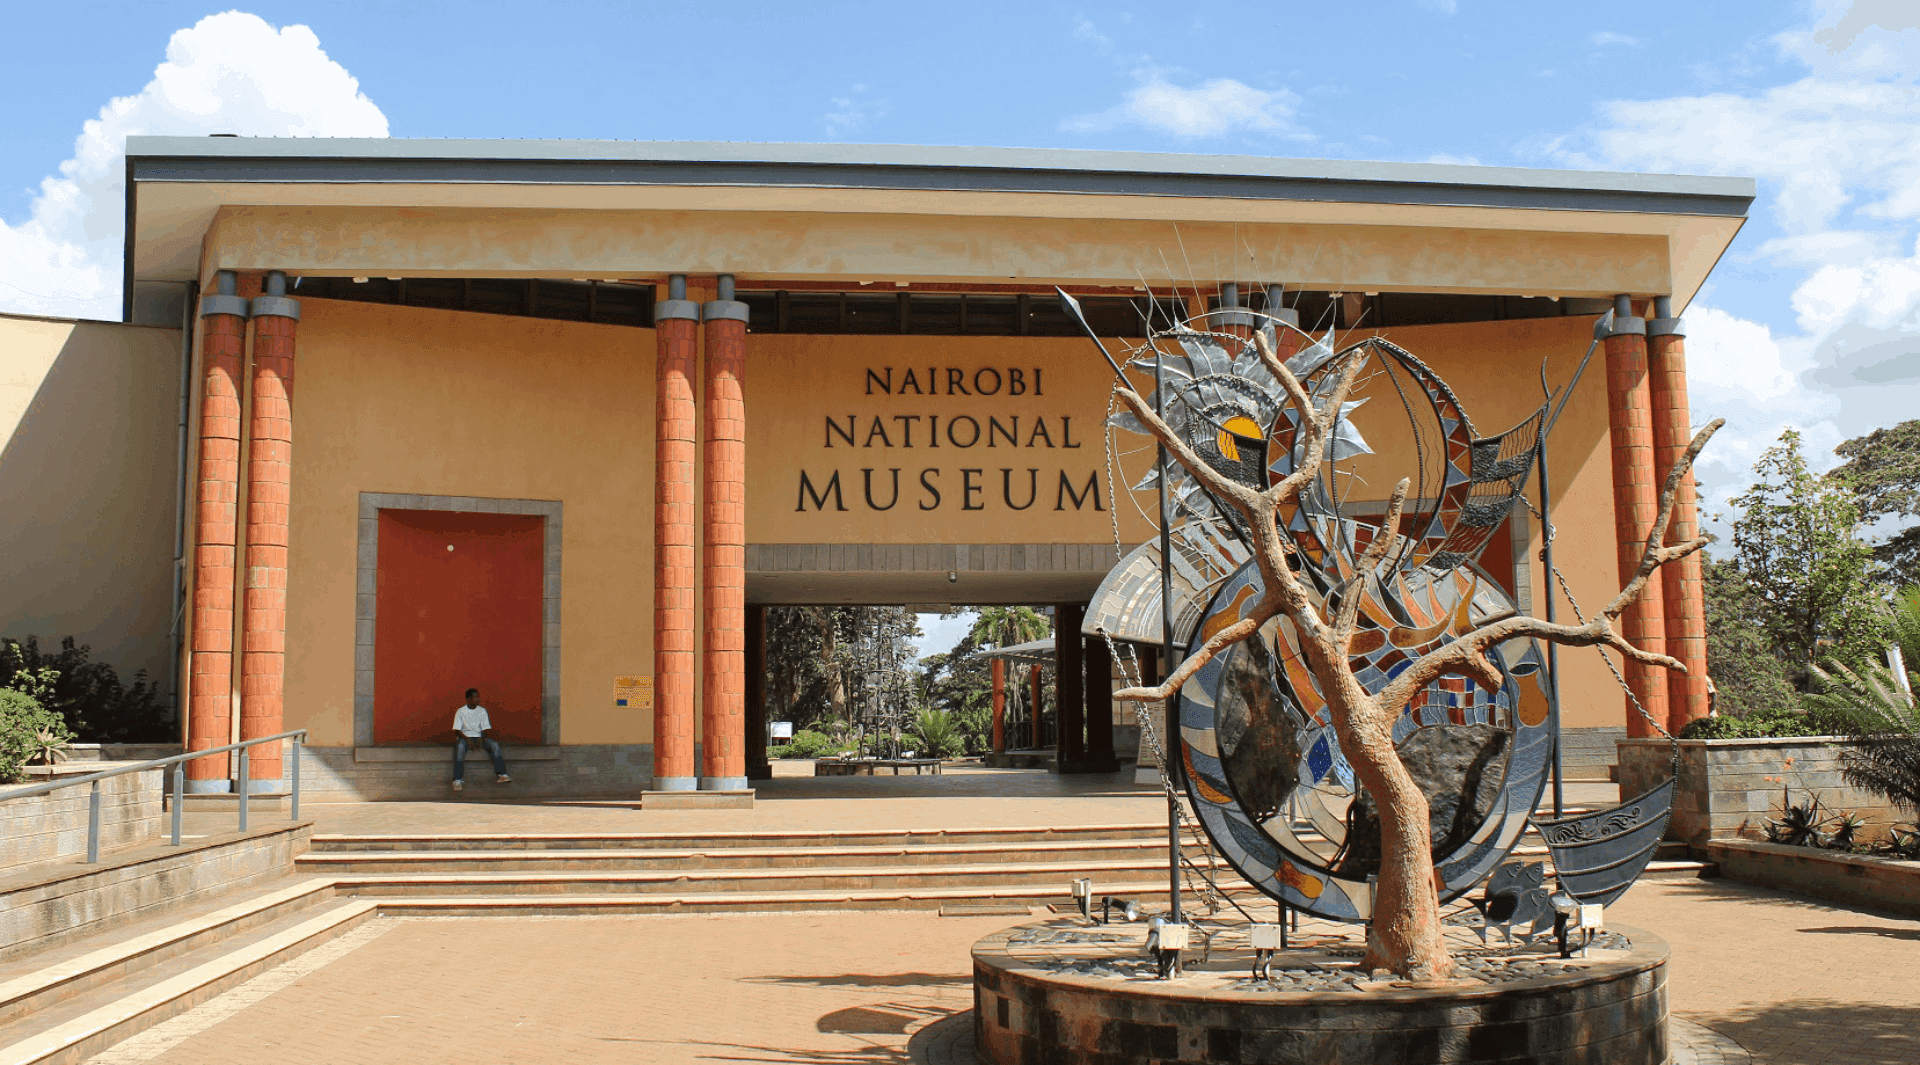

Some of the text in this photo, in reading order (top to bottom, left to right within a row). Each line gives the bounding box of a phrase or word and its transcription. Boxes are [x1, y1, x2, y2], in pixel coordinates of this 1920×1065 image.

[865, 367, 1043, 396] NAIROBI
[823, 415, 1081, 448] NATIONAL
[794, 468, 1106, 511] MUSEUM
